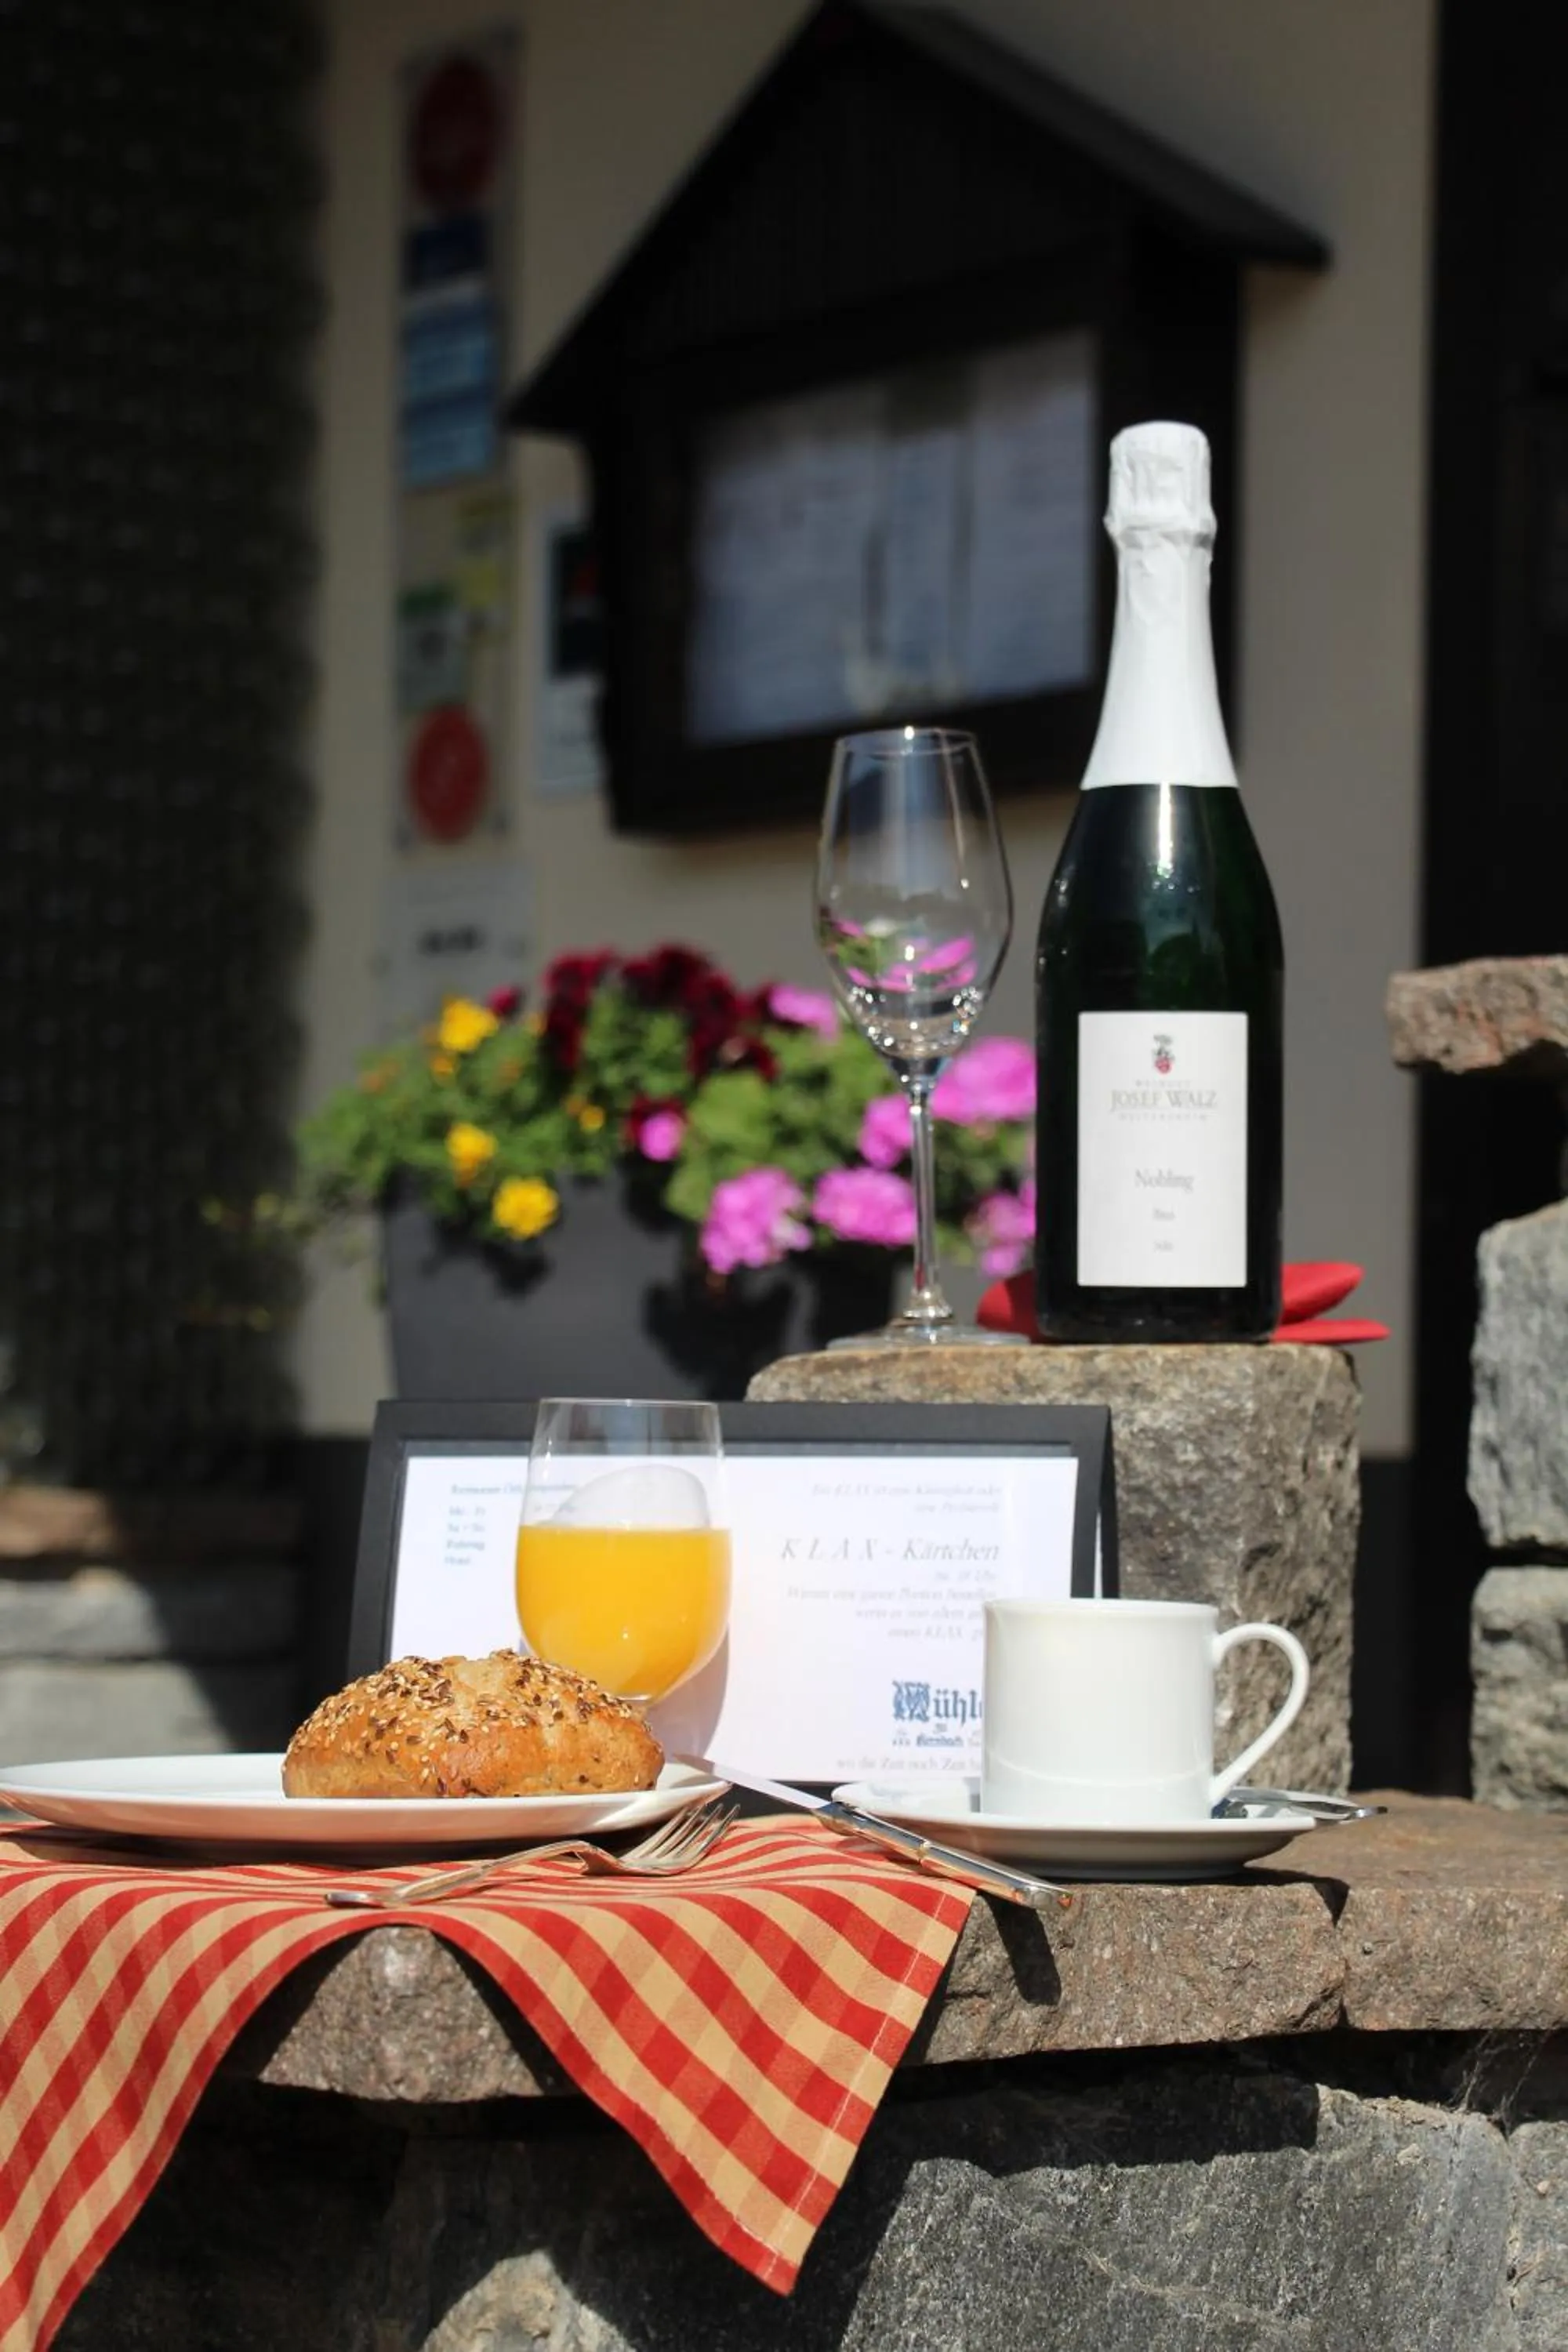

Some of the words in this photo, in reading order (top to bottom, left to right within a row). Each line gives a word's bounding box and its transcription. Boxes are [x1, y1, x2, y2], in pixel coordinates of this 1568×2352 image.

[1110, 1090, 1161, 1112] JOSEF
[1165, 1090, 1218, 1109] WALZ
[891, 1679, 982, 1726] Mühl
